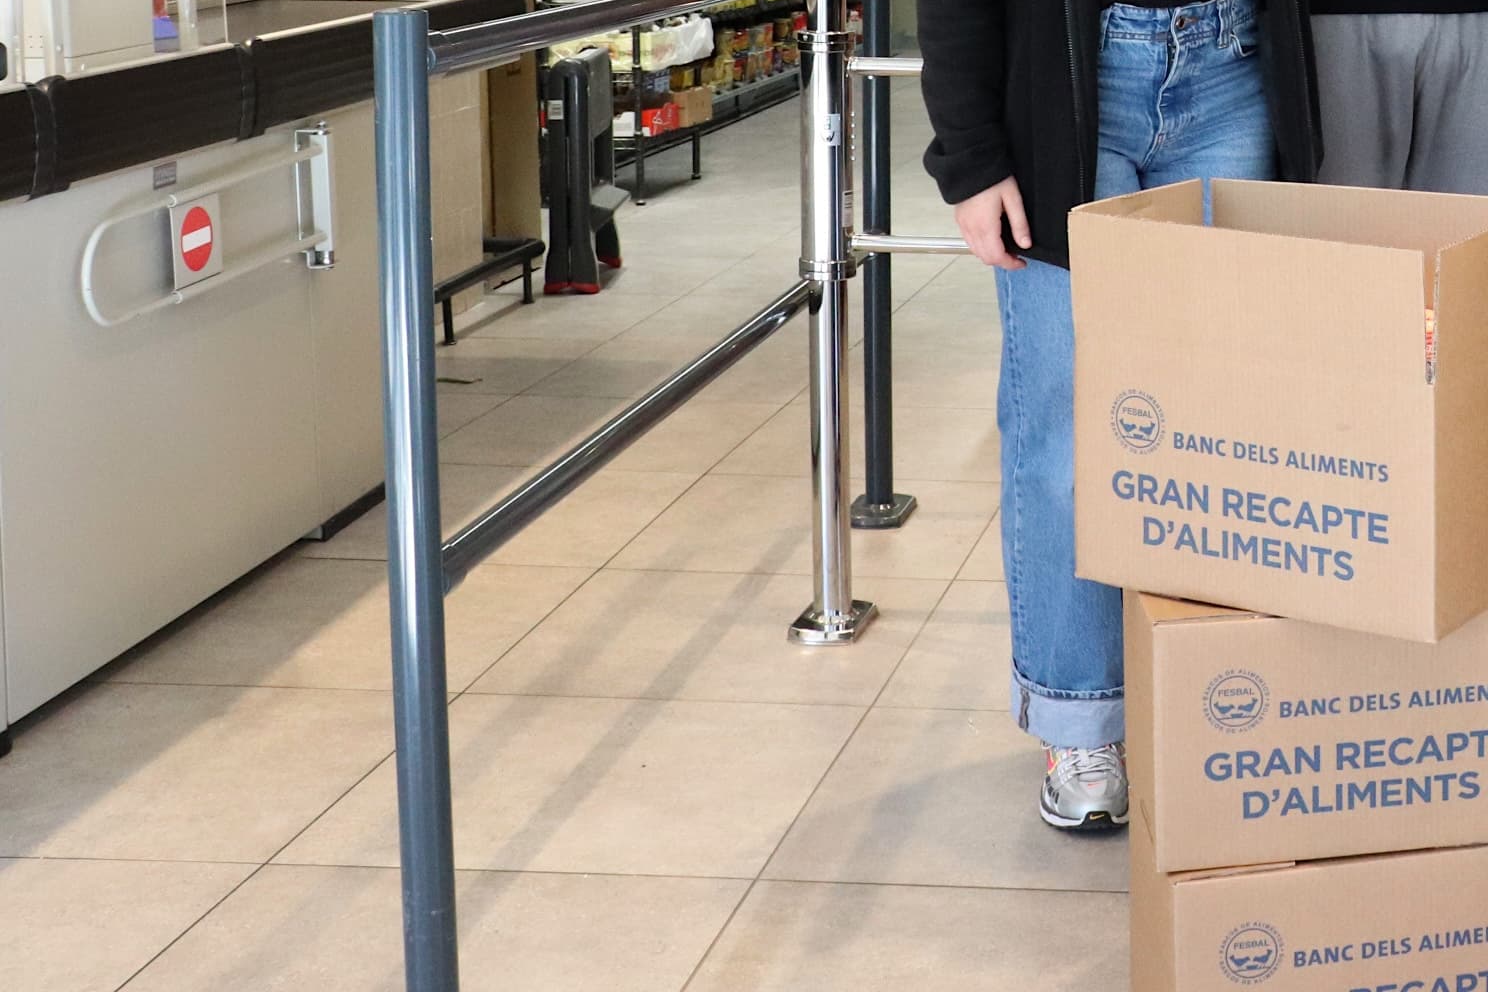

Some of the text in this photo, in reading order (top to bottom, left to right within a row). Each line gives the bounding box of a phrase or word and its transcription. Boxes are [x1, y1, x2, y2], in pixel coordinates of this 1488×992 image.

[1122, 407, 1152, 418] FESBAL
[1173, 432, 1389, 482] BANC DELS ALIMENTS
[1112, 470, 1389, 544] GRAN RECAPTE
[1143, 516, 1354, 581] D'ALIMENTS
[1218, 688, 1255, 697] FESBAL
[1280, 697, 1341, 718] BANC
[1349, 693, 1401, 712] DELS
[1204, 745, 1321, 782] GRAN
[1242, 771, 1481, 820] D'ALIMENTS
[1234, 939, 1269, 950] FESBAL
[1294, 945, 1354, 968] BANC
[1361, 937, 1412, 959] DELS
